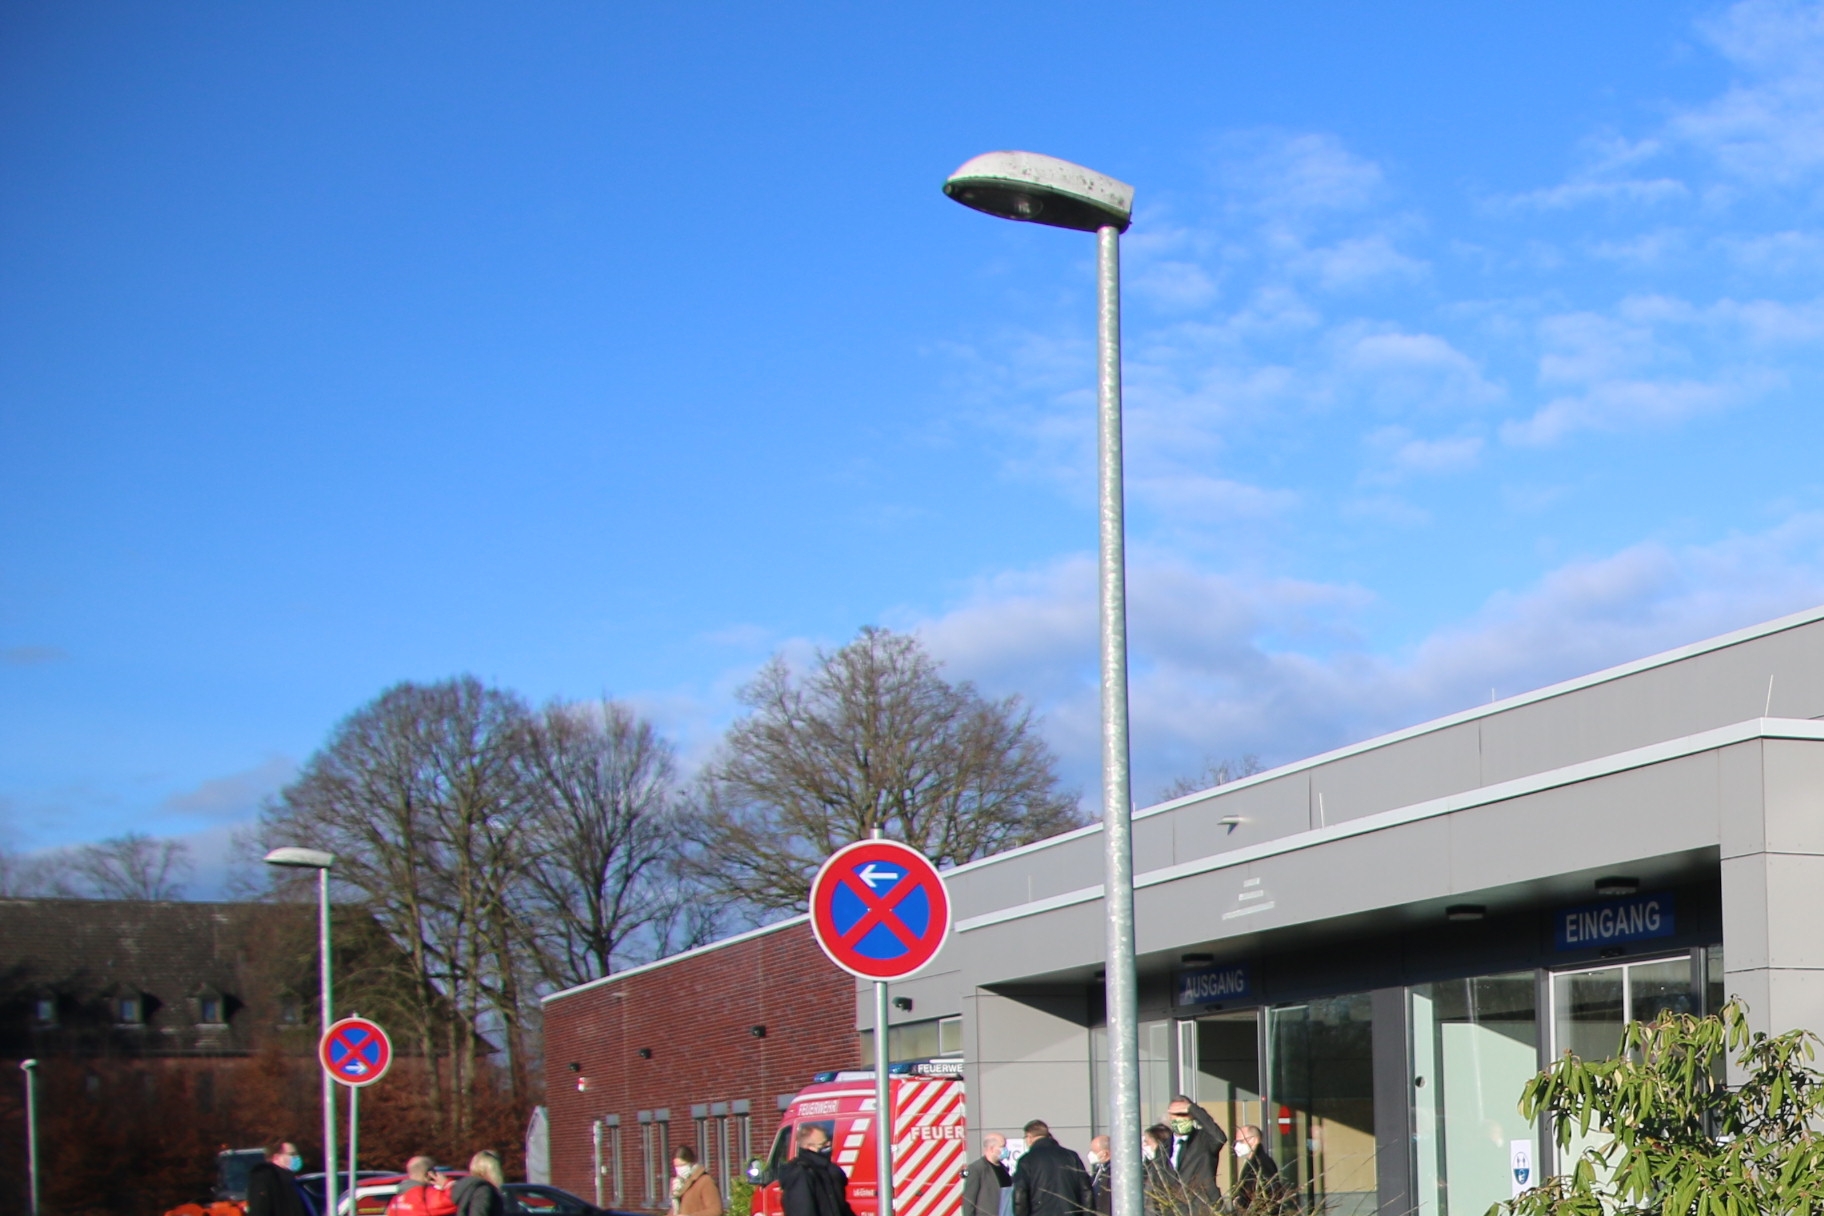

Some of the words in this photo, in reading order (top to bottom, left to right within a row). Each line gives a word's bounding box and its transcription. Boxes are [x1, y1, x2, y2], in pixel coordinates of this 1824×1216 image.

[1565, 900, 1661, 943] EINGANG
[1184, 968, 1245, 1000] AUSGANG
[917, 1063, 964, 1074] FEUERWE
[910, 1125, 966, 1140] FEUER
